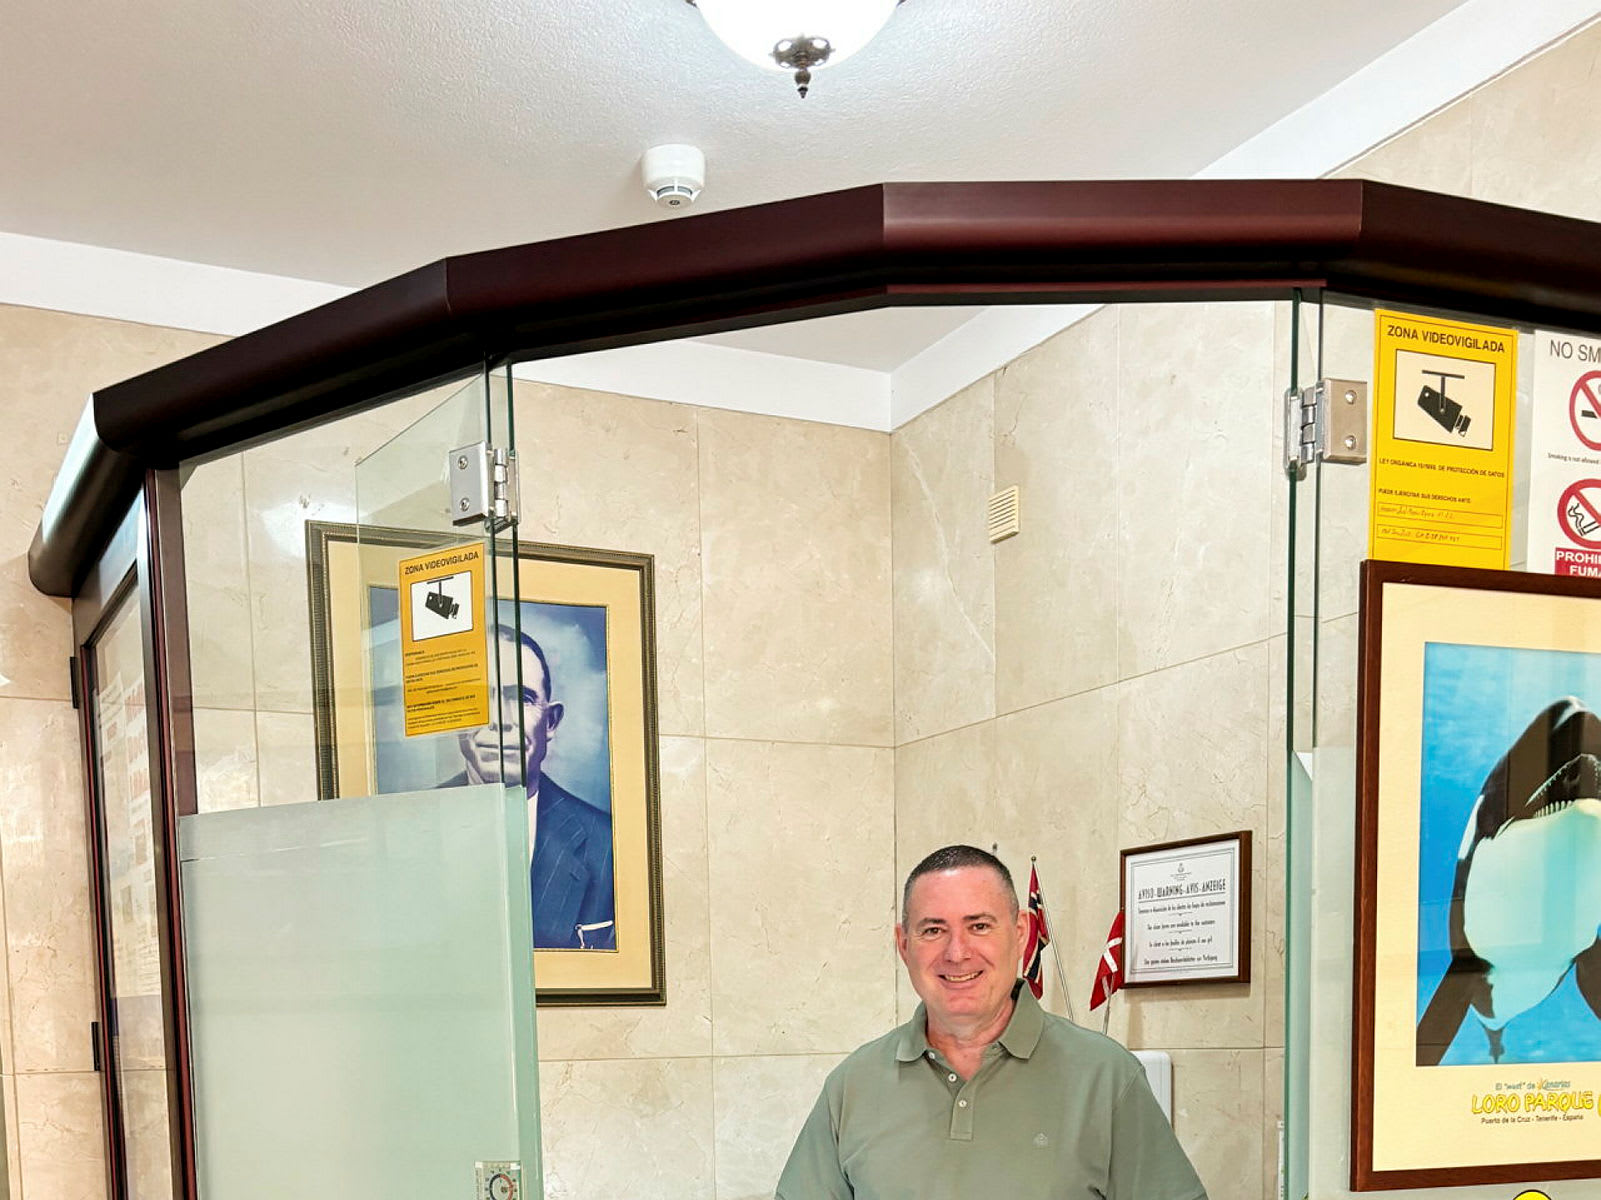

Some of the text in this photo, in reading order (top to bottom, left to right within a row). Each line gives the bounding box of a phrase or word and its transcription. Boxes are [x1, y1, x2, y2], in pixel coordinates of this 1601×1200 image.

[1387, 325, 1505, 353] ZONA VIDEOVIGILADA
[1550, 339, 1573, 359] NO
[404, 551, 479, 575] ZONA VIDEOVIGILADA
[1471, 1091, 1593, 1114] LORO PARQUE
